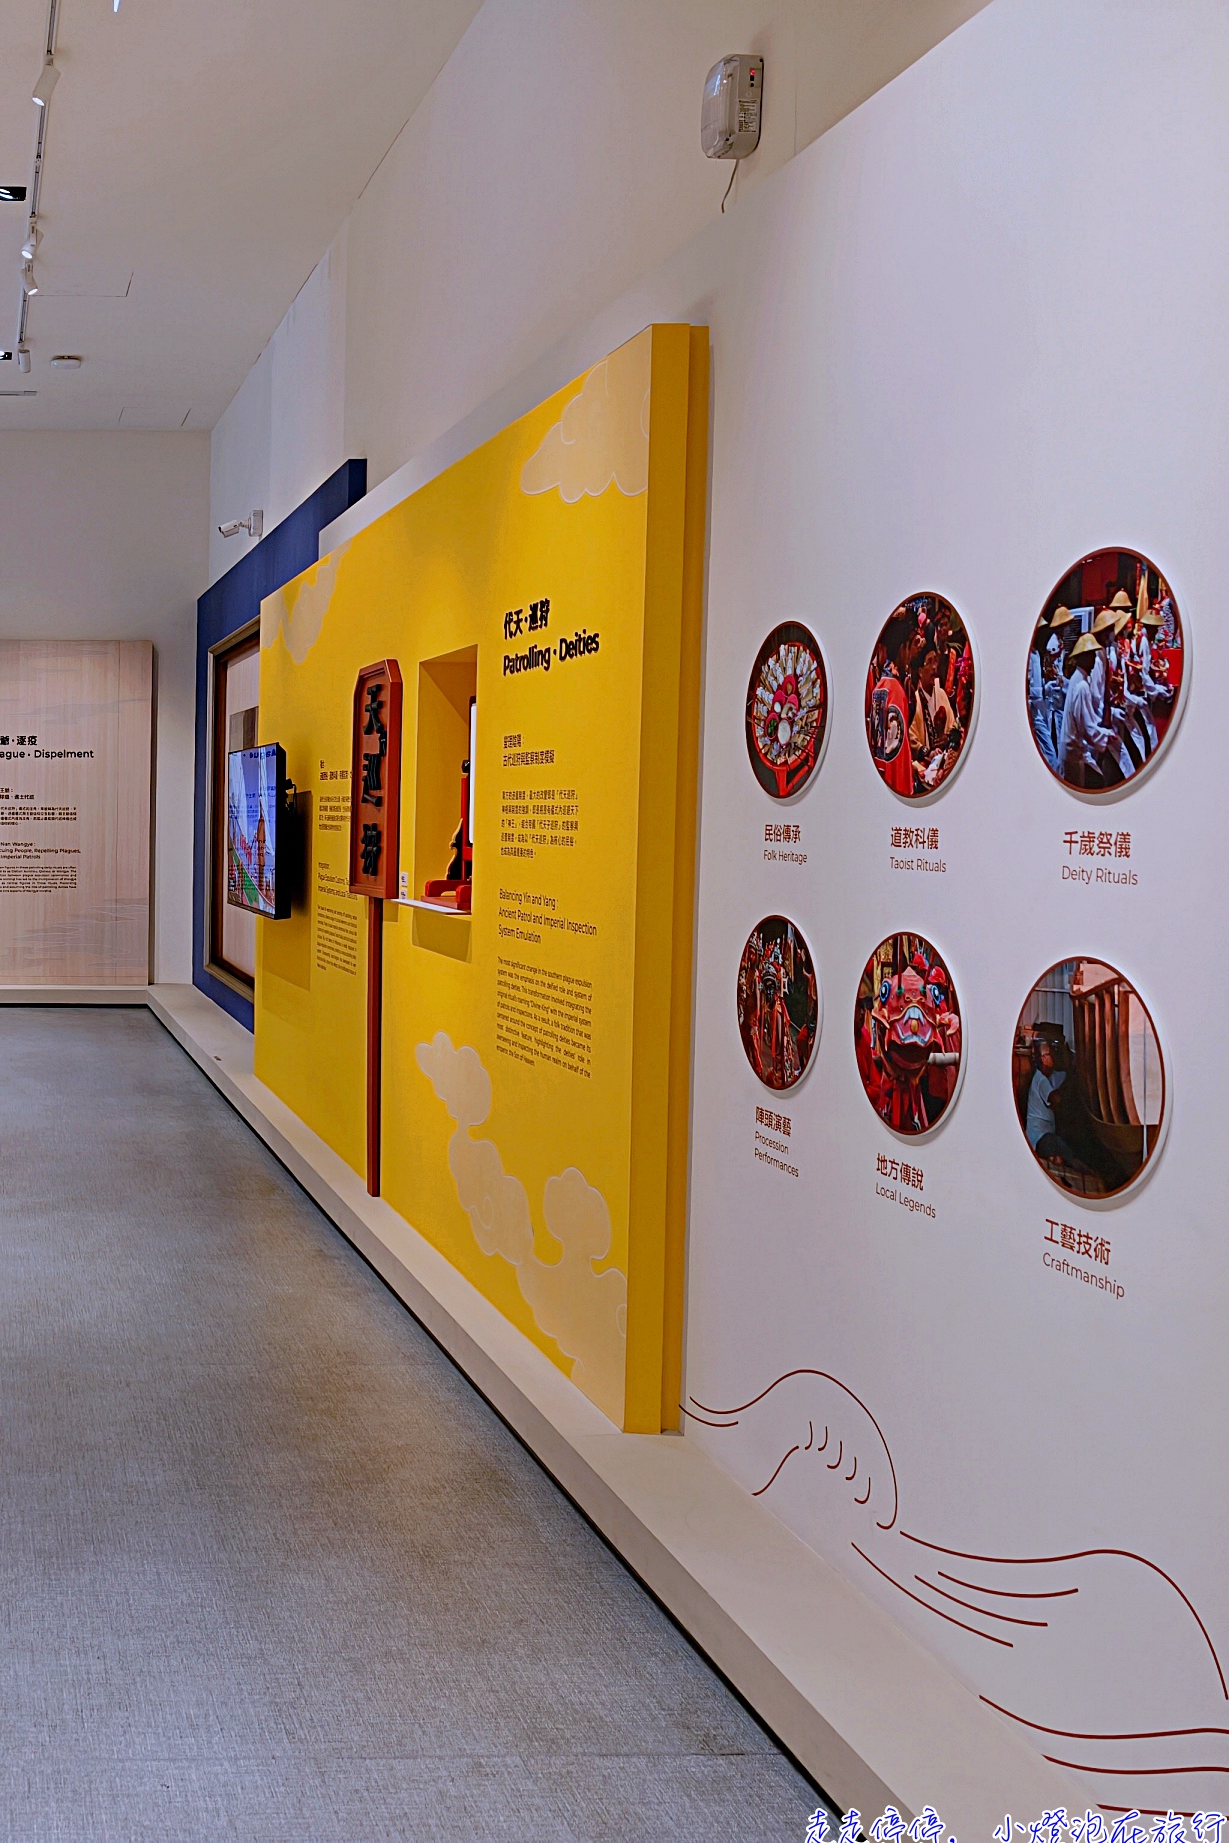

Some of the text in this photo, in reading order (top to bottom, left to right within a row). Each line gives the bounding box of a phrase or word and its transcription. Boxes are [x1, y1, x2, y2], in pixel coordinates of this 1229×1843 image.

[502, 628, 600, 677] Patrolling Deities
[34, 749, 95, 760] Dispelment
[764, 824, 801, 844] 民俗傳承
[890, 826, 939, 850] 道教科儀
[1062, 830, 1131, 858] 千歲祭儀
[763, 849, 808, 866] Folk Heritage
[889, 856, 947, 873] Taoist Rituals
[1062, 865, 1139, 886] Deity Rituals
[499, 888, 523, 905] Balancing
[523, 892, 531, 904] Yin
[531, 894, 542, 906] and
[498, 906, 598, 936] Ancient Patrol and Imperial Inspection
[498, 924, 542, 944] System Emulation
[755, 1106, 792, 1138] 陣頭演藝
[754, 1130, 789, 1155] Procession
[754, 1147, 799, 1178] Performances
[876, 1152, 924, 1191] 地方傳說
[875, 1182, 937, 1219] Local Legends
[1043, 1218, 1111, 1266] 工藝技術
[1042, 1252, 1125, 1300] Craftmanship
